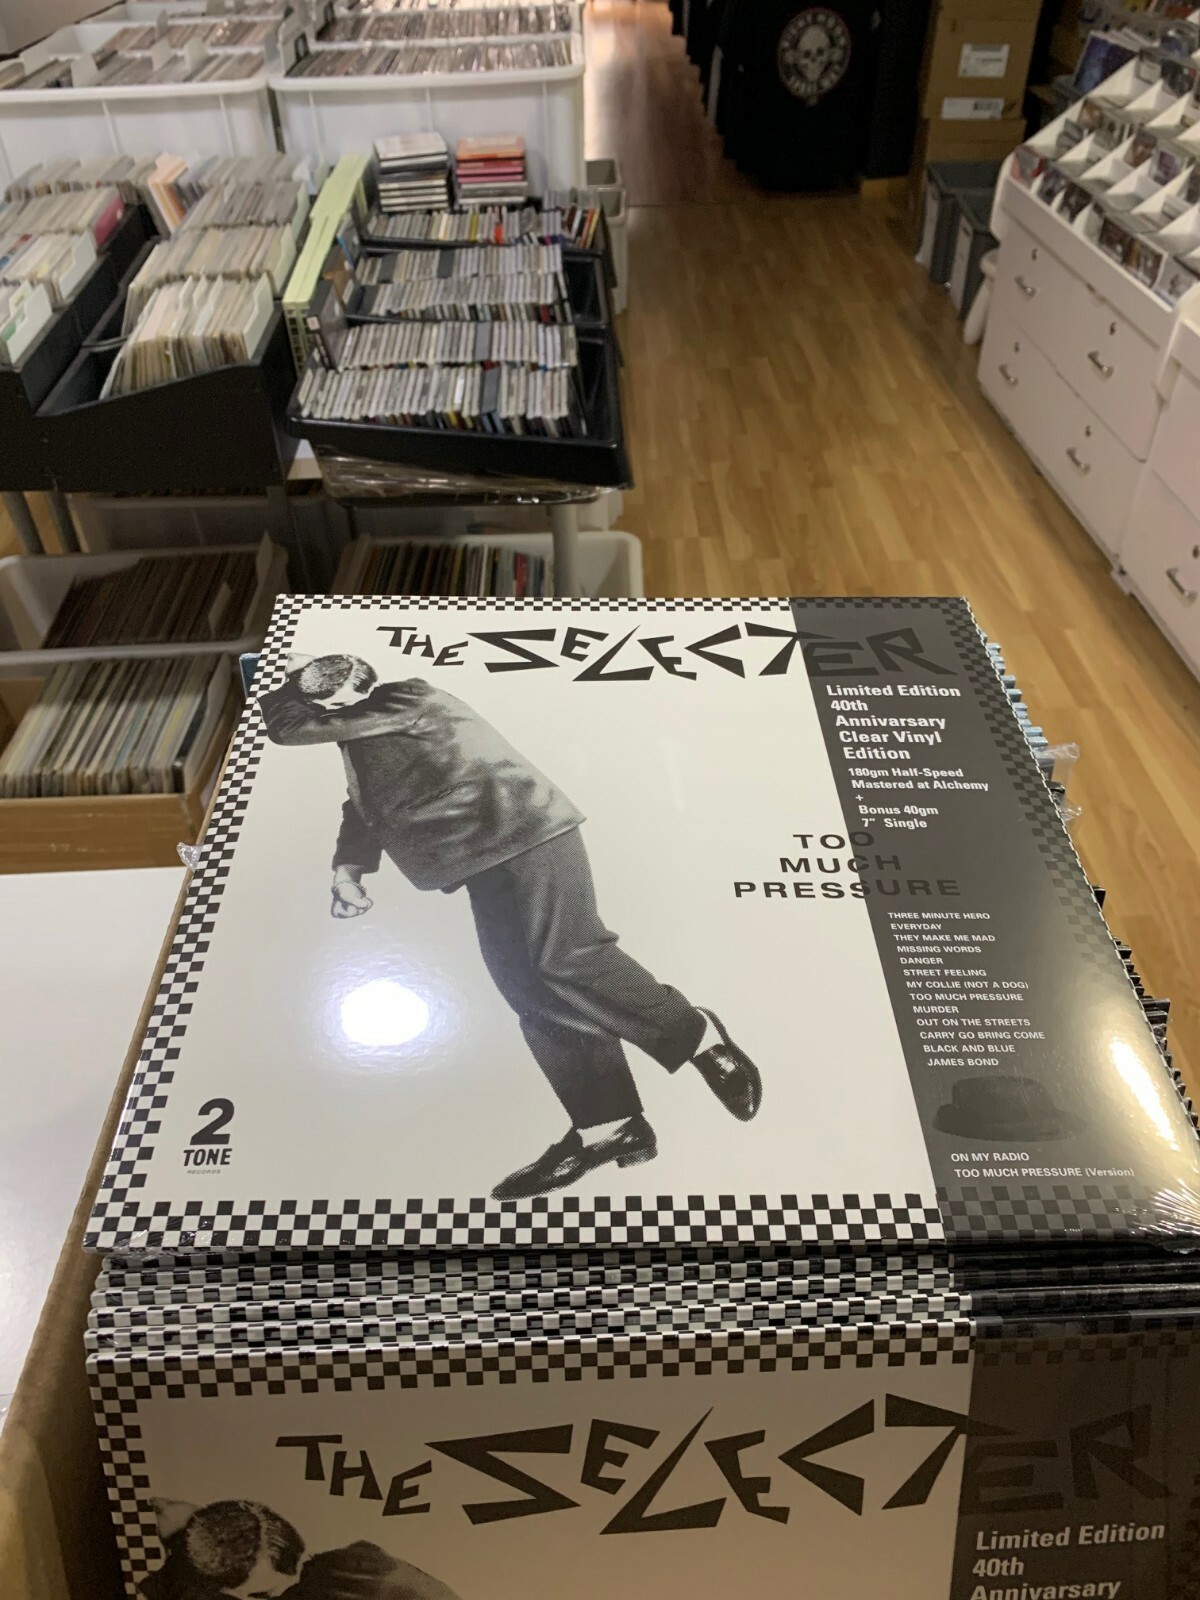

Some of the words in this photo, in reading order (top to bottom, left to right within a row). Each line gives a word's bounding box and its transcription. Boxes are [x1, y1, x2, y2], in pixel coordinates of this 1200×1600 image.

[376, 626, 468, 666] THE
[466, 622, 959, 681] SELECTER
[826, 684, 894, 696] Limited
[897, 685, 961, 697] Edition
[830, 700, 869, 711] 40th
[835, 715, 946, 730] Annivarsary
[839, 731, 889, 742] Clear
[892, 731, 942, 746] Vinyl
[843, 747, 911, 760] Edition
[848, 768, 890, 778] 180gm
[891, 768, 964, 778] Half-Speed
[851, 780, 914, 789] Mastered
[917, 781, 930, 789] at
[933, 781, 989, 791] Alchemy
[859, 805, 901, 815] Bonus
[903, 805, 939, 816] 40gm
[861, 818, 876, 827] 7"
[883, 818, 928, 830] Single
[792, 831, 875, 850] TOO
[779, 855, 901, 874] MUCH
[733, 879, 962, 899] PRESSURE
[893, 934, 920, 942] THEY
[922, 934, 952, 942] MAKE
[954, 934, 970, 942] ME
[971, 934, 996, 942] MAD
[906, 981, 923, 989] MY
[925, 981, 961, 989] COLLIE
[964, 981, 989, 989] (NOT
[992, 981, 1000, 989] A
[1002, 981, 1029, 989] DOG)
[916, 1018, 938, 1026] OUT
[942, 1018, 959, 1026] ON
[960, 1018, 982, 1026] THE
[984, 1018, 1031, 1026] STREETS
[923, 1044, 959, 1052] BLACK
[962, 1044, 985, 1052] AND
[987, 1044, 1016, 1052] BLUE
[927, 1058, 964, 1066] JAMES
[967, 1058, 999, 1066] BOND
[190, 1098, 234, 1145] 2
[183, 1148, 232, 1166] TONE
[951, 1153, 969, 1162] ON
[971, 1153, 990, 1162] MY
[993, 1153, 1030, 1162] RADIO
[954, 1168, 980, 1178] TOO
[982, 1168, 1019, 1178] MUCH
[1021, 1168, 1083, 1178] PRESSURE
[1085, 1168, 1135, 1178] (Version)
[275, 1434, 433, 1516] THE
[425, 1393, 1173, 1535] SELECTER
[976, 1526, 1071, 1551] Limited
[1078, 1522, 1166, 1545] Edition
[972, 1556, 1025, 1578] 40th
